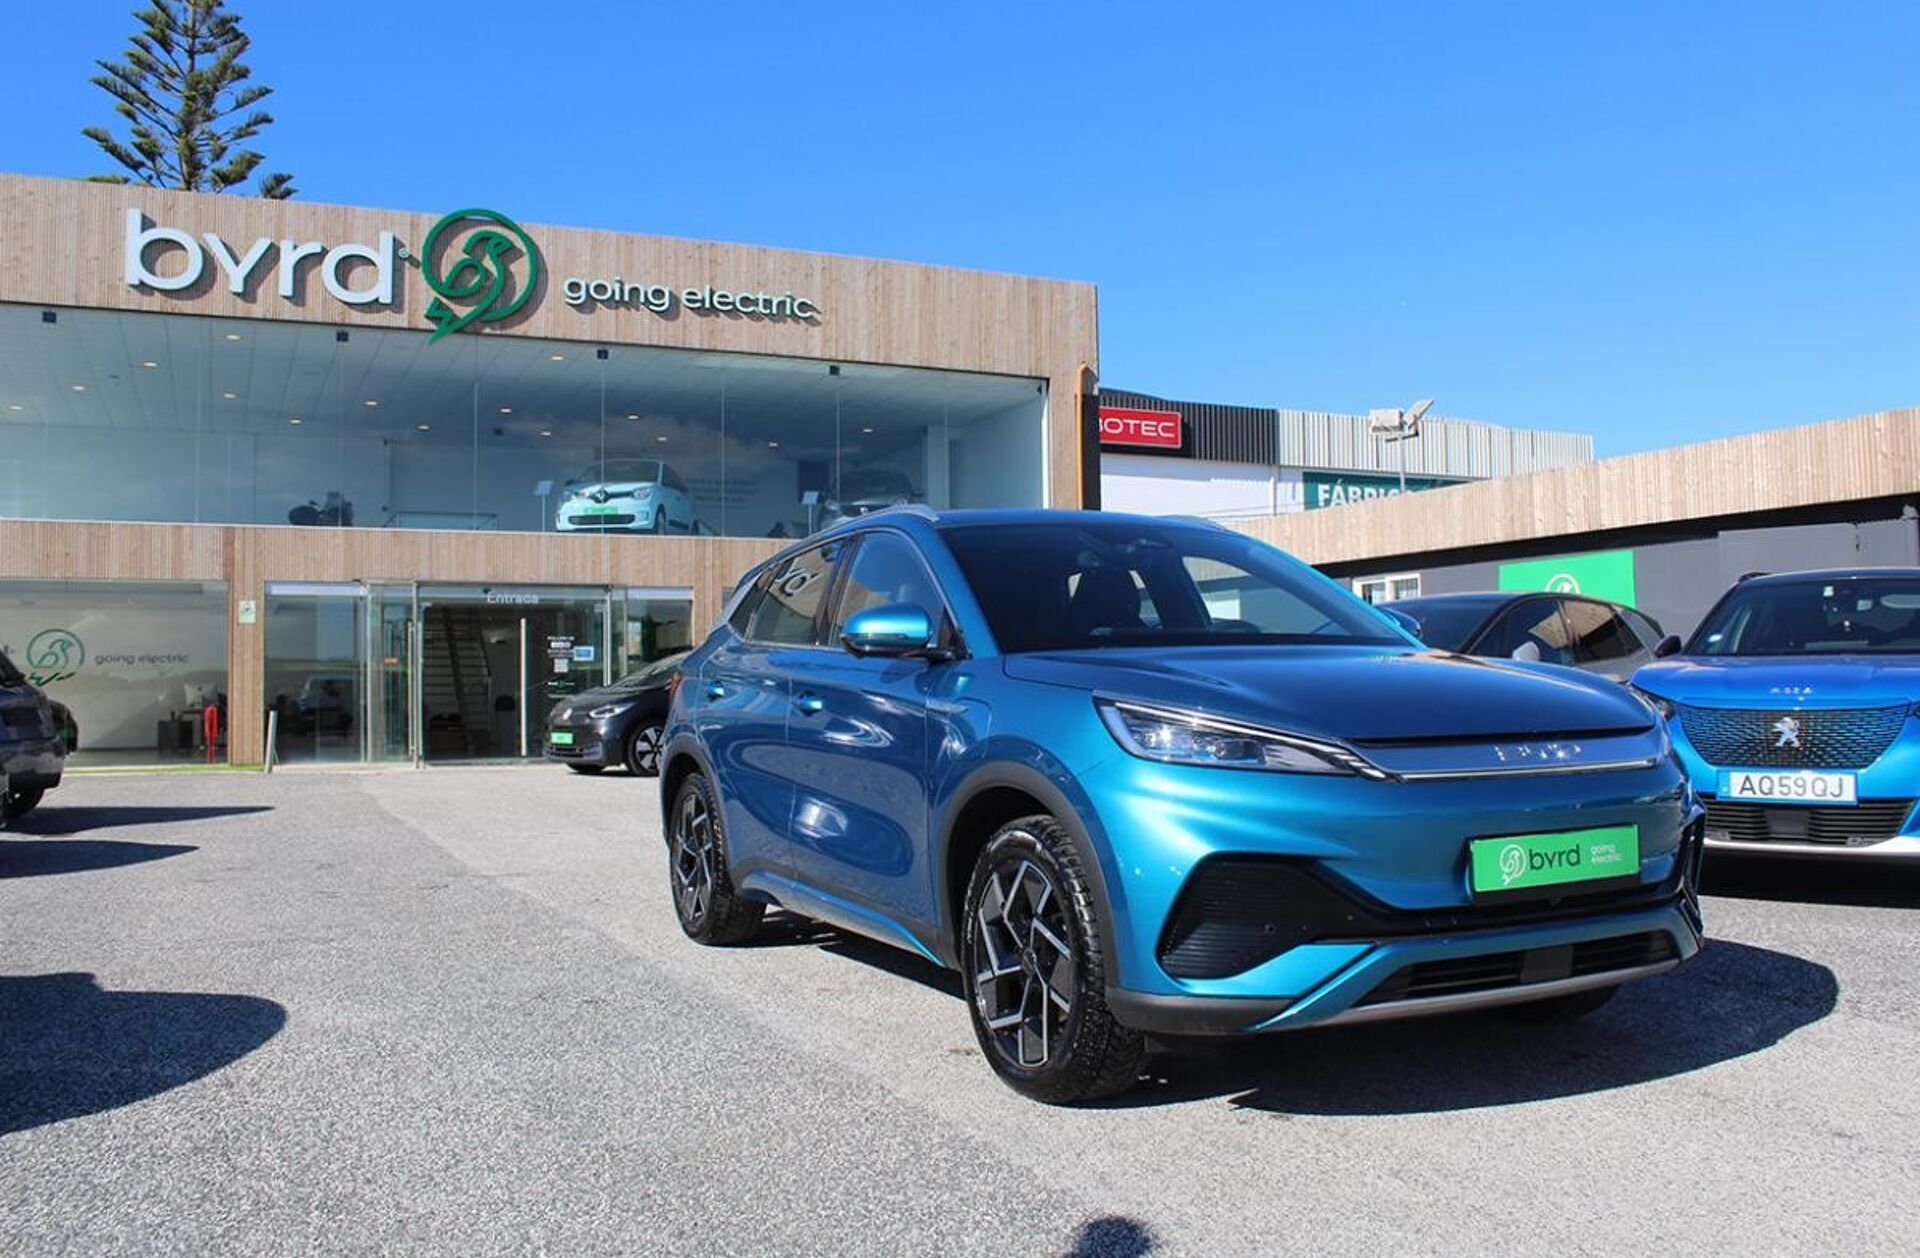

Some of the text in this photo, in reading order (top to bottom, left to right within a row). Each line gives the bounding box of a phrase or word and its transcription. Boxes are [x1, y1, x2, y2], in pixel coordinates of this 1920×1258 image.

[563, 276, 813, 318] going electric
[1099, 417, 1176, 438] OTEC
[94, 653, 135, 666] going
[1738, 774, 1843, 798] AQ59QJ
[1528, 843, 1581, 871] byrd
